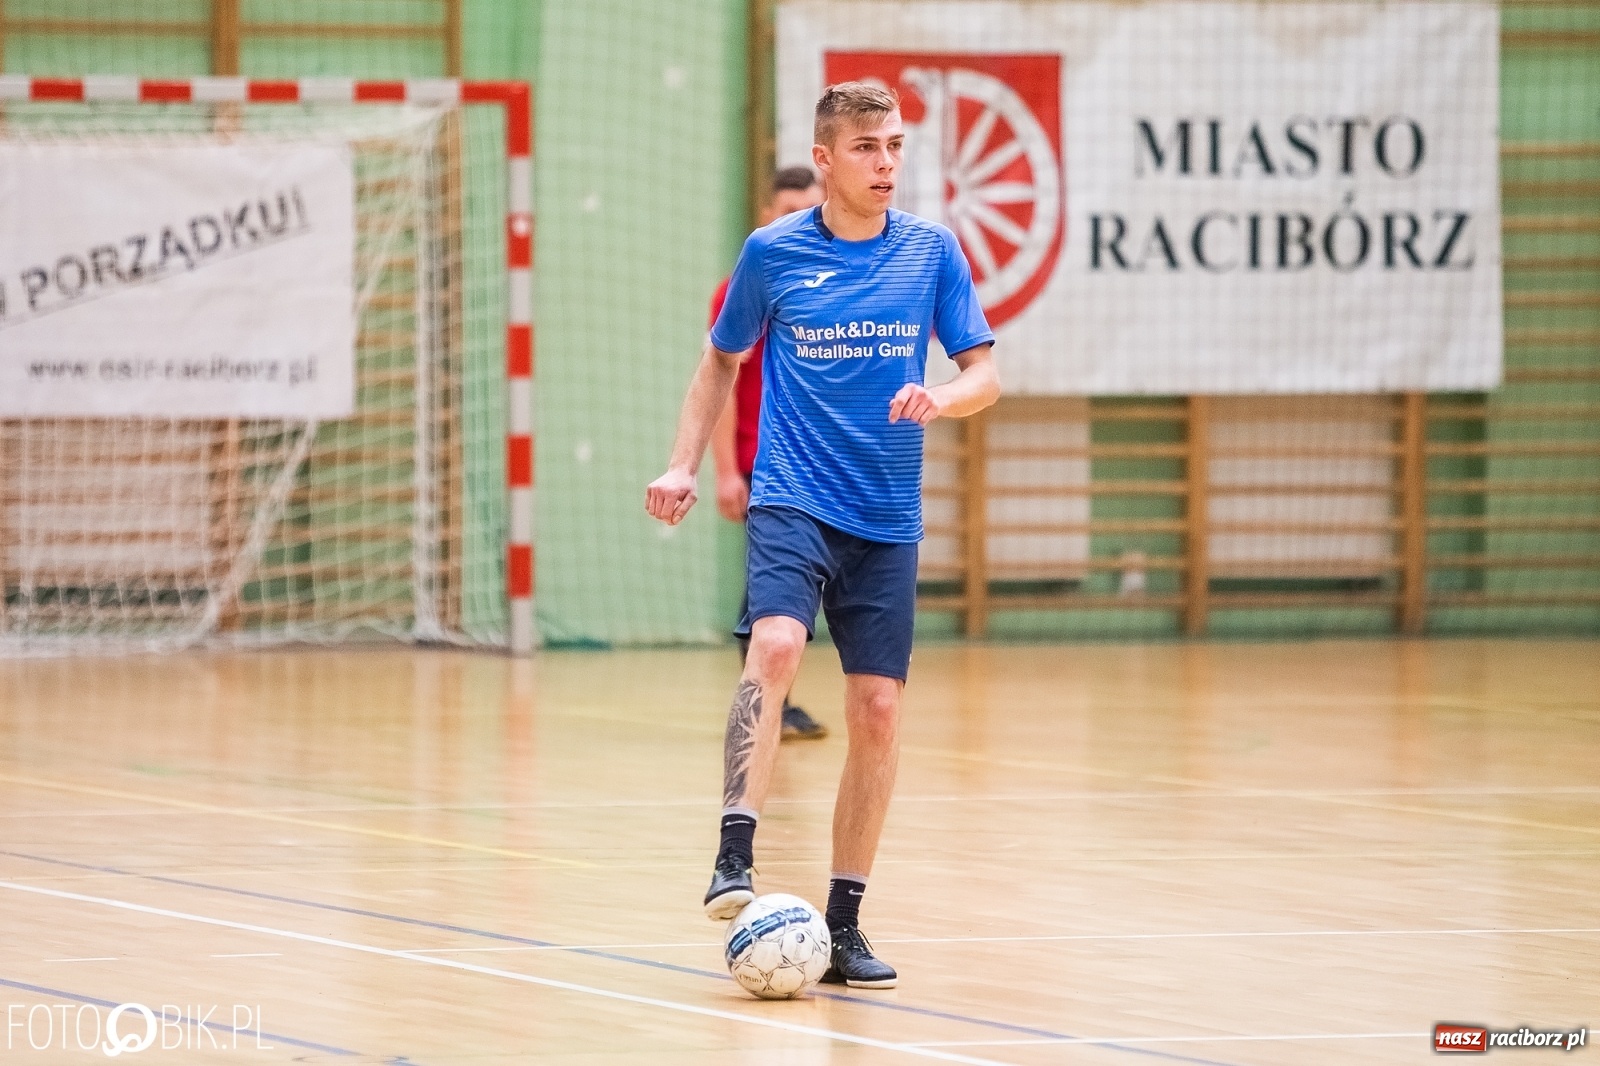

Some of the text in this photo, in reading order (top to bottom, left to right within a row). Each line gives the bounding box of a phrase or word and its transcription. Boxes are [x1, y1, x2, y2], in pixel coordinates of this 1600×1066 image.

[1133, 113, 1426, 180] MIASTO
[1087, 189, 1476, 272] RACIBÓRZ
[791, 320, 921, 341] Marek&Dariusz
[796, 344, 873, 359] Metallbau
